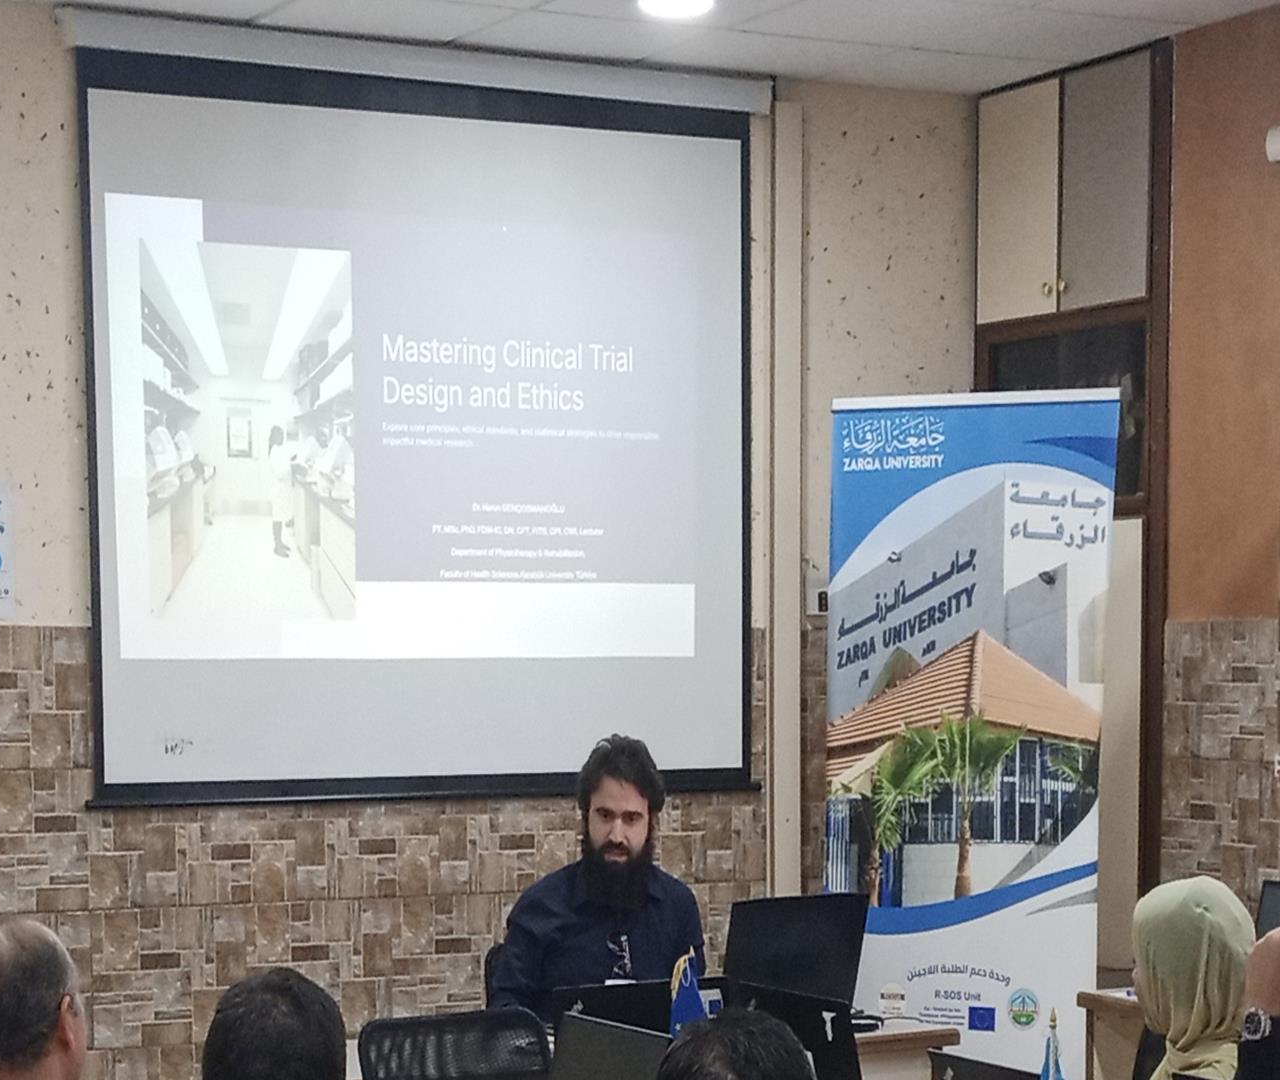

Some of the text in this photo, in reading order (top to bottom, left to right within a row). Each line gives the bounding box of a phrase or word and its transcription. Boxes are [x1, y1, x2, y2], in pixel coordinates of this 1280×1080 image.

[382, 333, 634, 374] Mastering Clinical Trial
[383, 376, 585, 413] Design and Ethics
[843, 454, 945, 472] ZARQA UNIVERSITY
[1010, 481, 1106, 517] جامعة
[1010, 514, 1106, 551] الزرقاء
[837, 582, 976, 670] ZARQA UNIVERSITY
[940, 964, 968, 975] الطلبة
[969, 967, 987, 978] دعم
[988, 969, 1011, 987] وحدة
[934, 989, 982, 1002] R-SOS Unit
